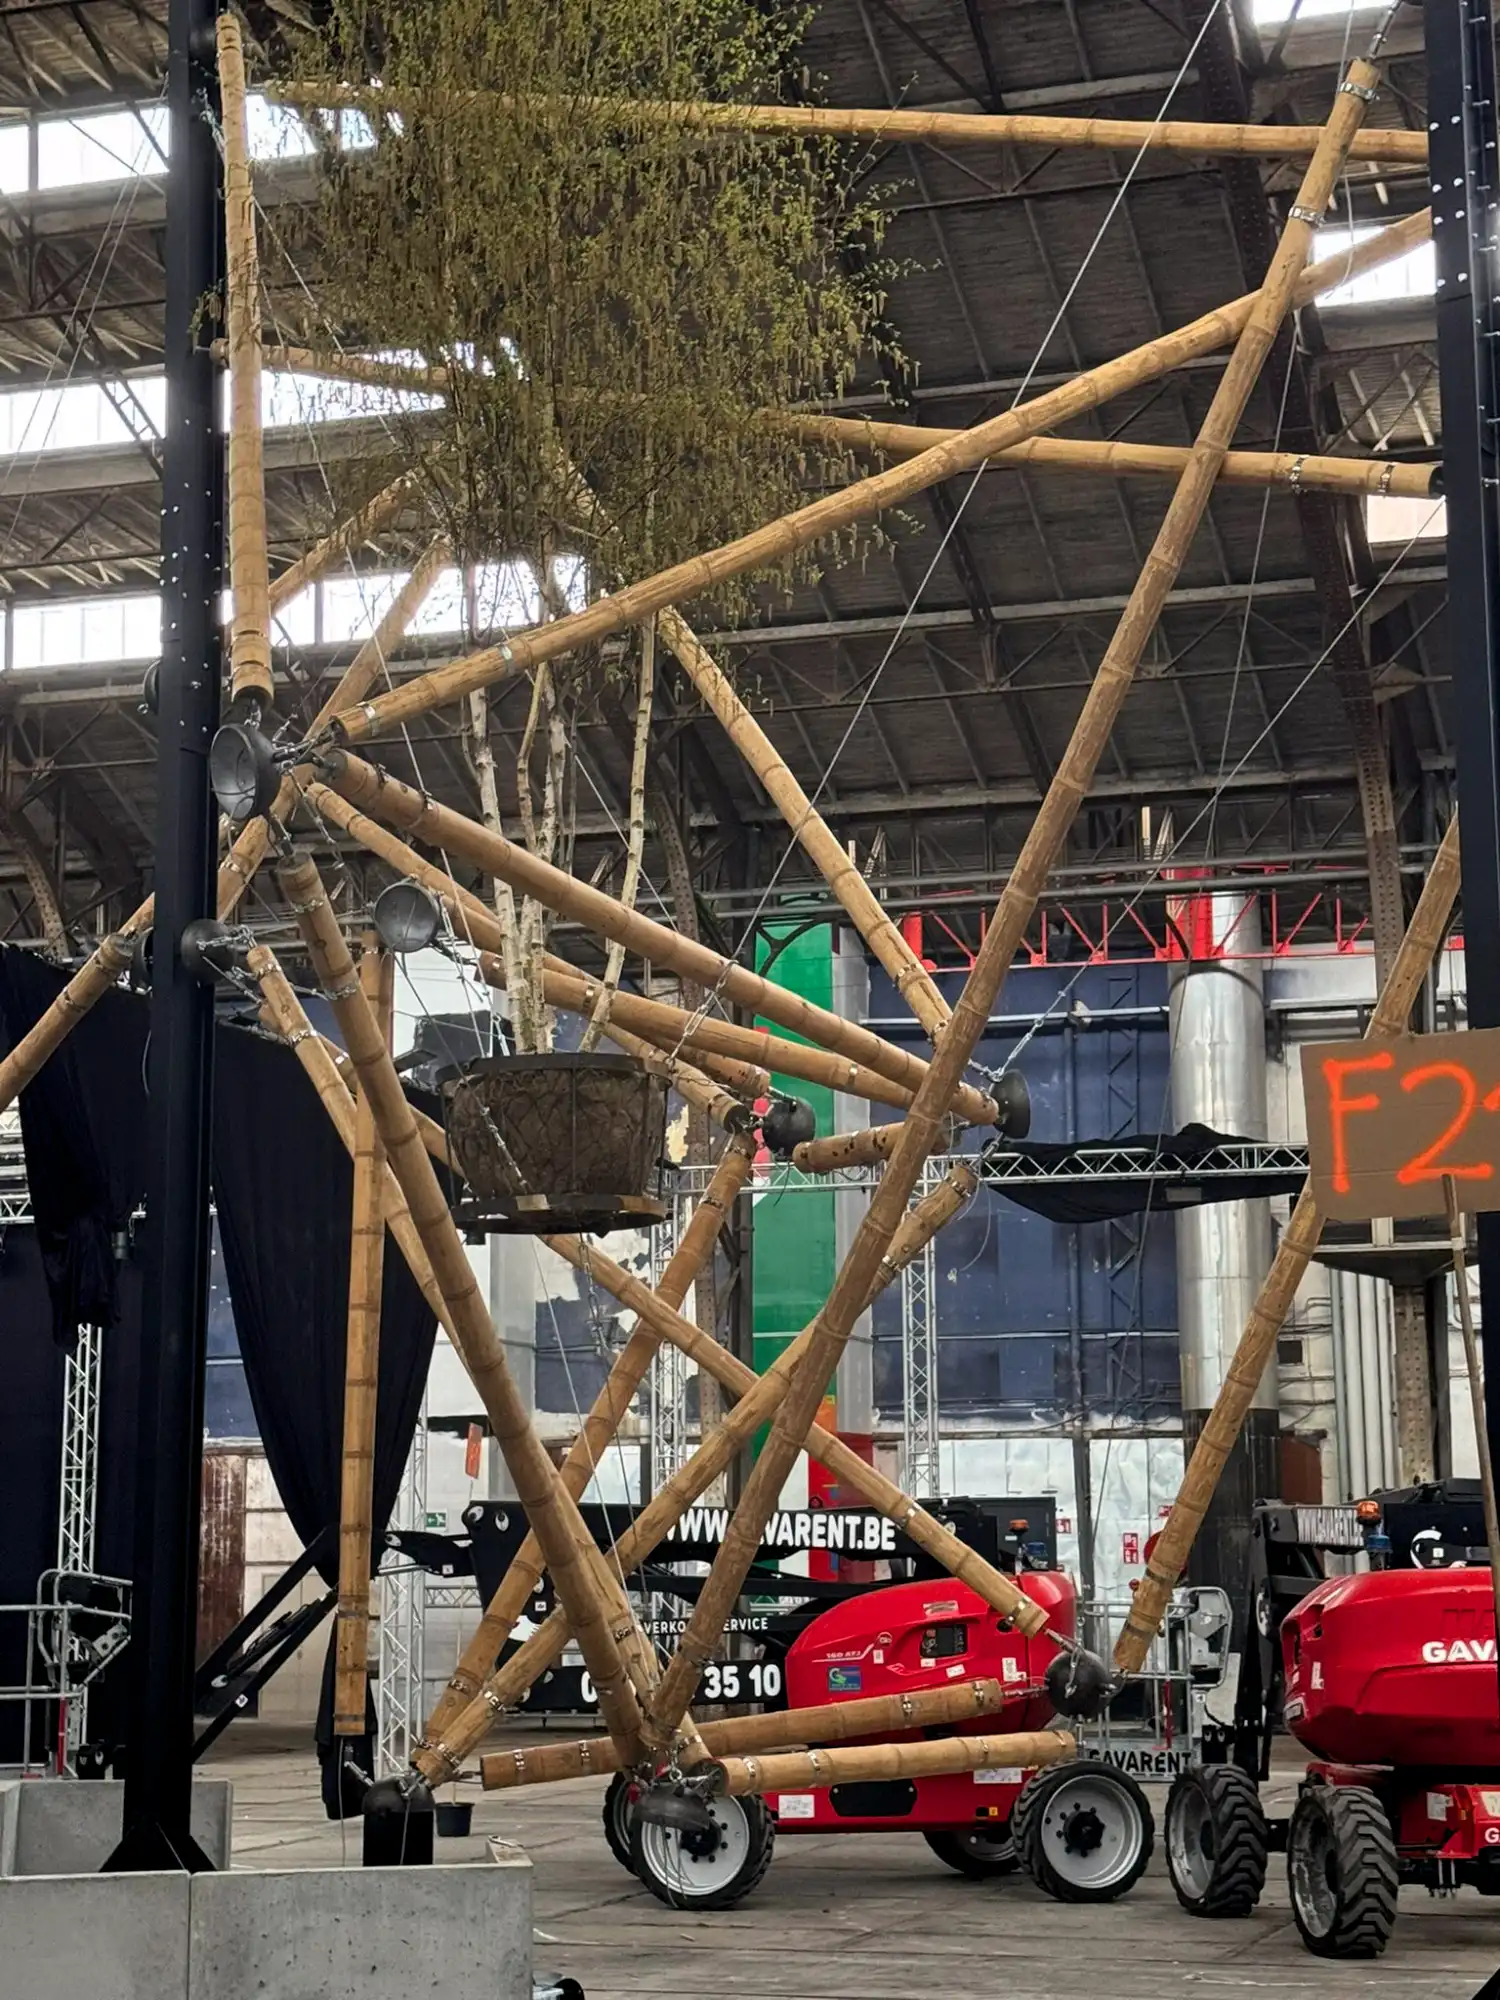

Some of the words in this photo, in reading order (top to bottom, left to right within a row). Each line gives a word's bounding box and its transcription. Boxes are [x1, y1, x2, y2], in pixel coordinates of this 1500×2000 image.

[1323, 1052, 1500, 1193] F2
[723, 1617, 769, 1632] ERVICE
[1421, 1639, 1499, 1664] GAV
[703, 1664, 740, 1699] 35
[748, 1663, 781, 1697] 10
